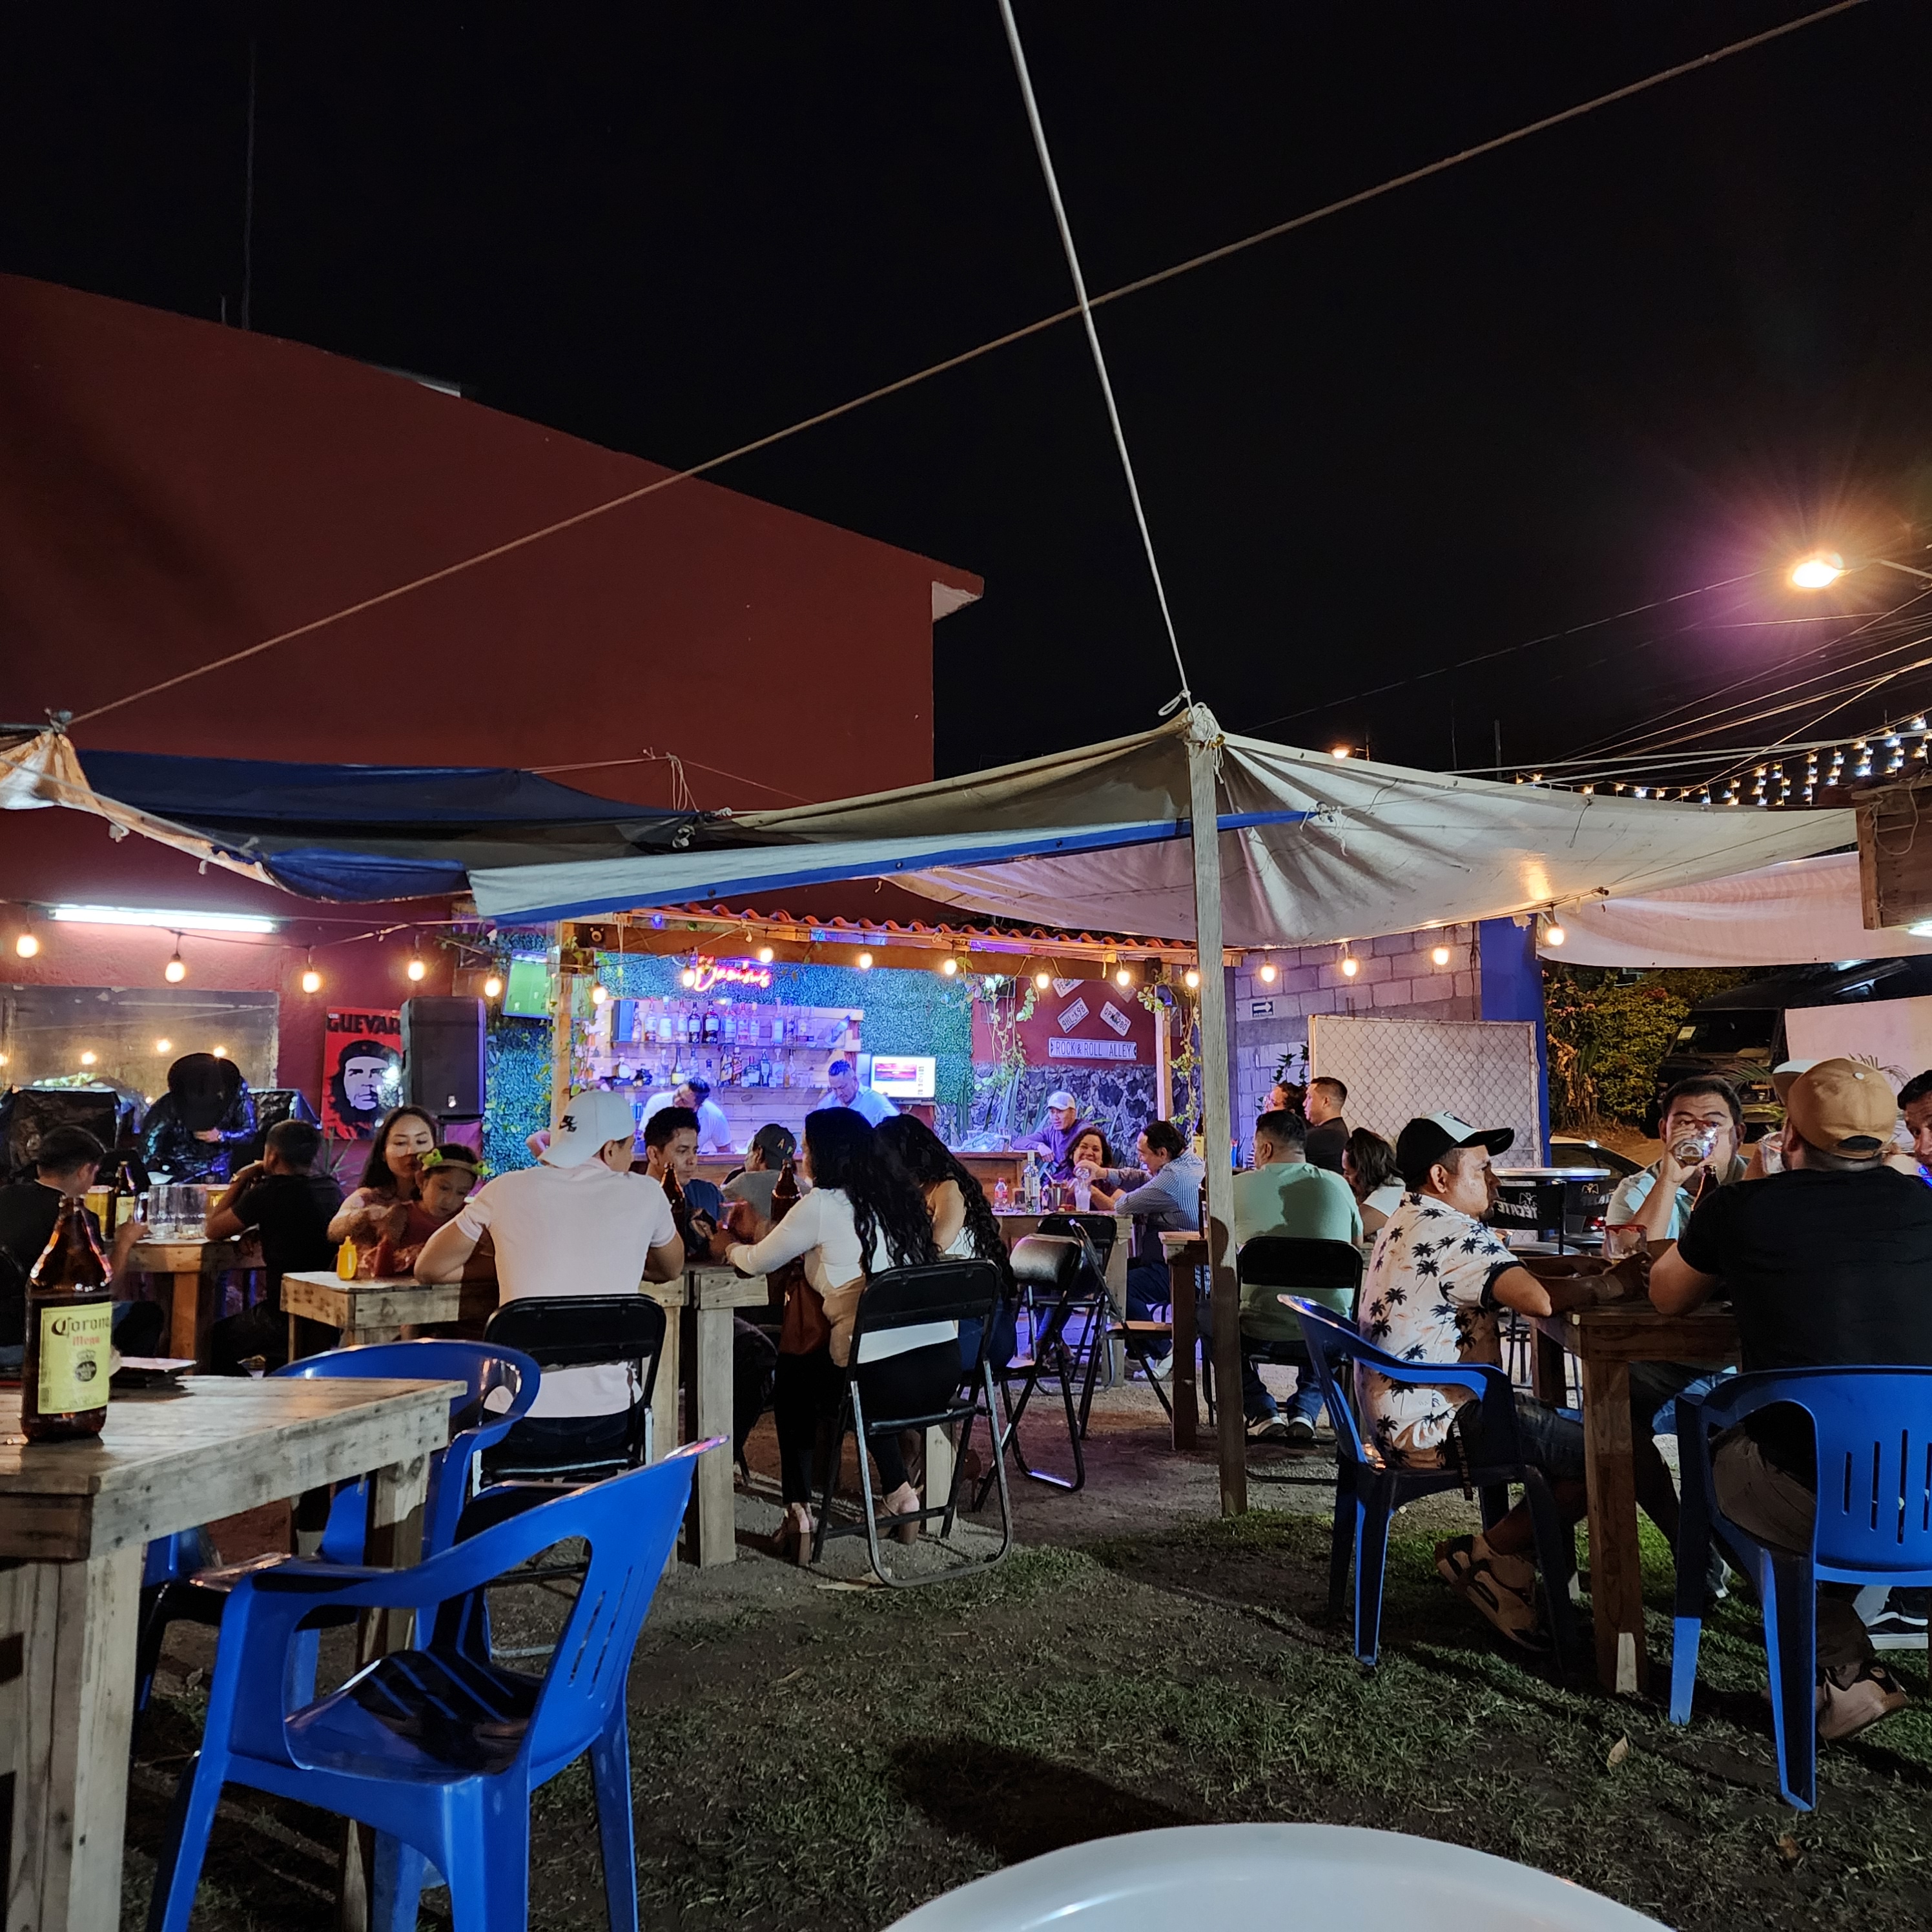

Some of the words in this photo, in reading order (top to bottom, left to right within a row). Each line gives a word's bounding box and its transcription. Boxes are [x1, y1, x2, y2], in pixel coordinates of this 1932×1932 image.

[326, 1013, 400, 1034] GUEVAR
[1056, 1041, 1075, 1055] ROCK
[1077, 1043, 1082, 1054] &
[1084, 1042, 1102, 1056] ROLL
[1109, 1044, 1131, 1058] ALLEY
